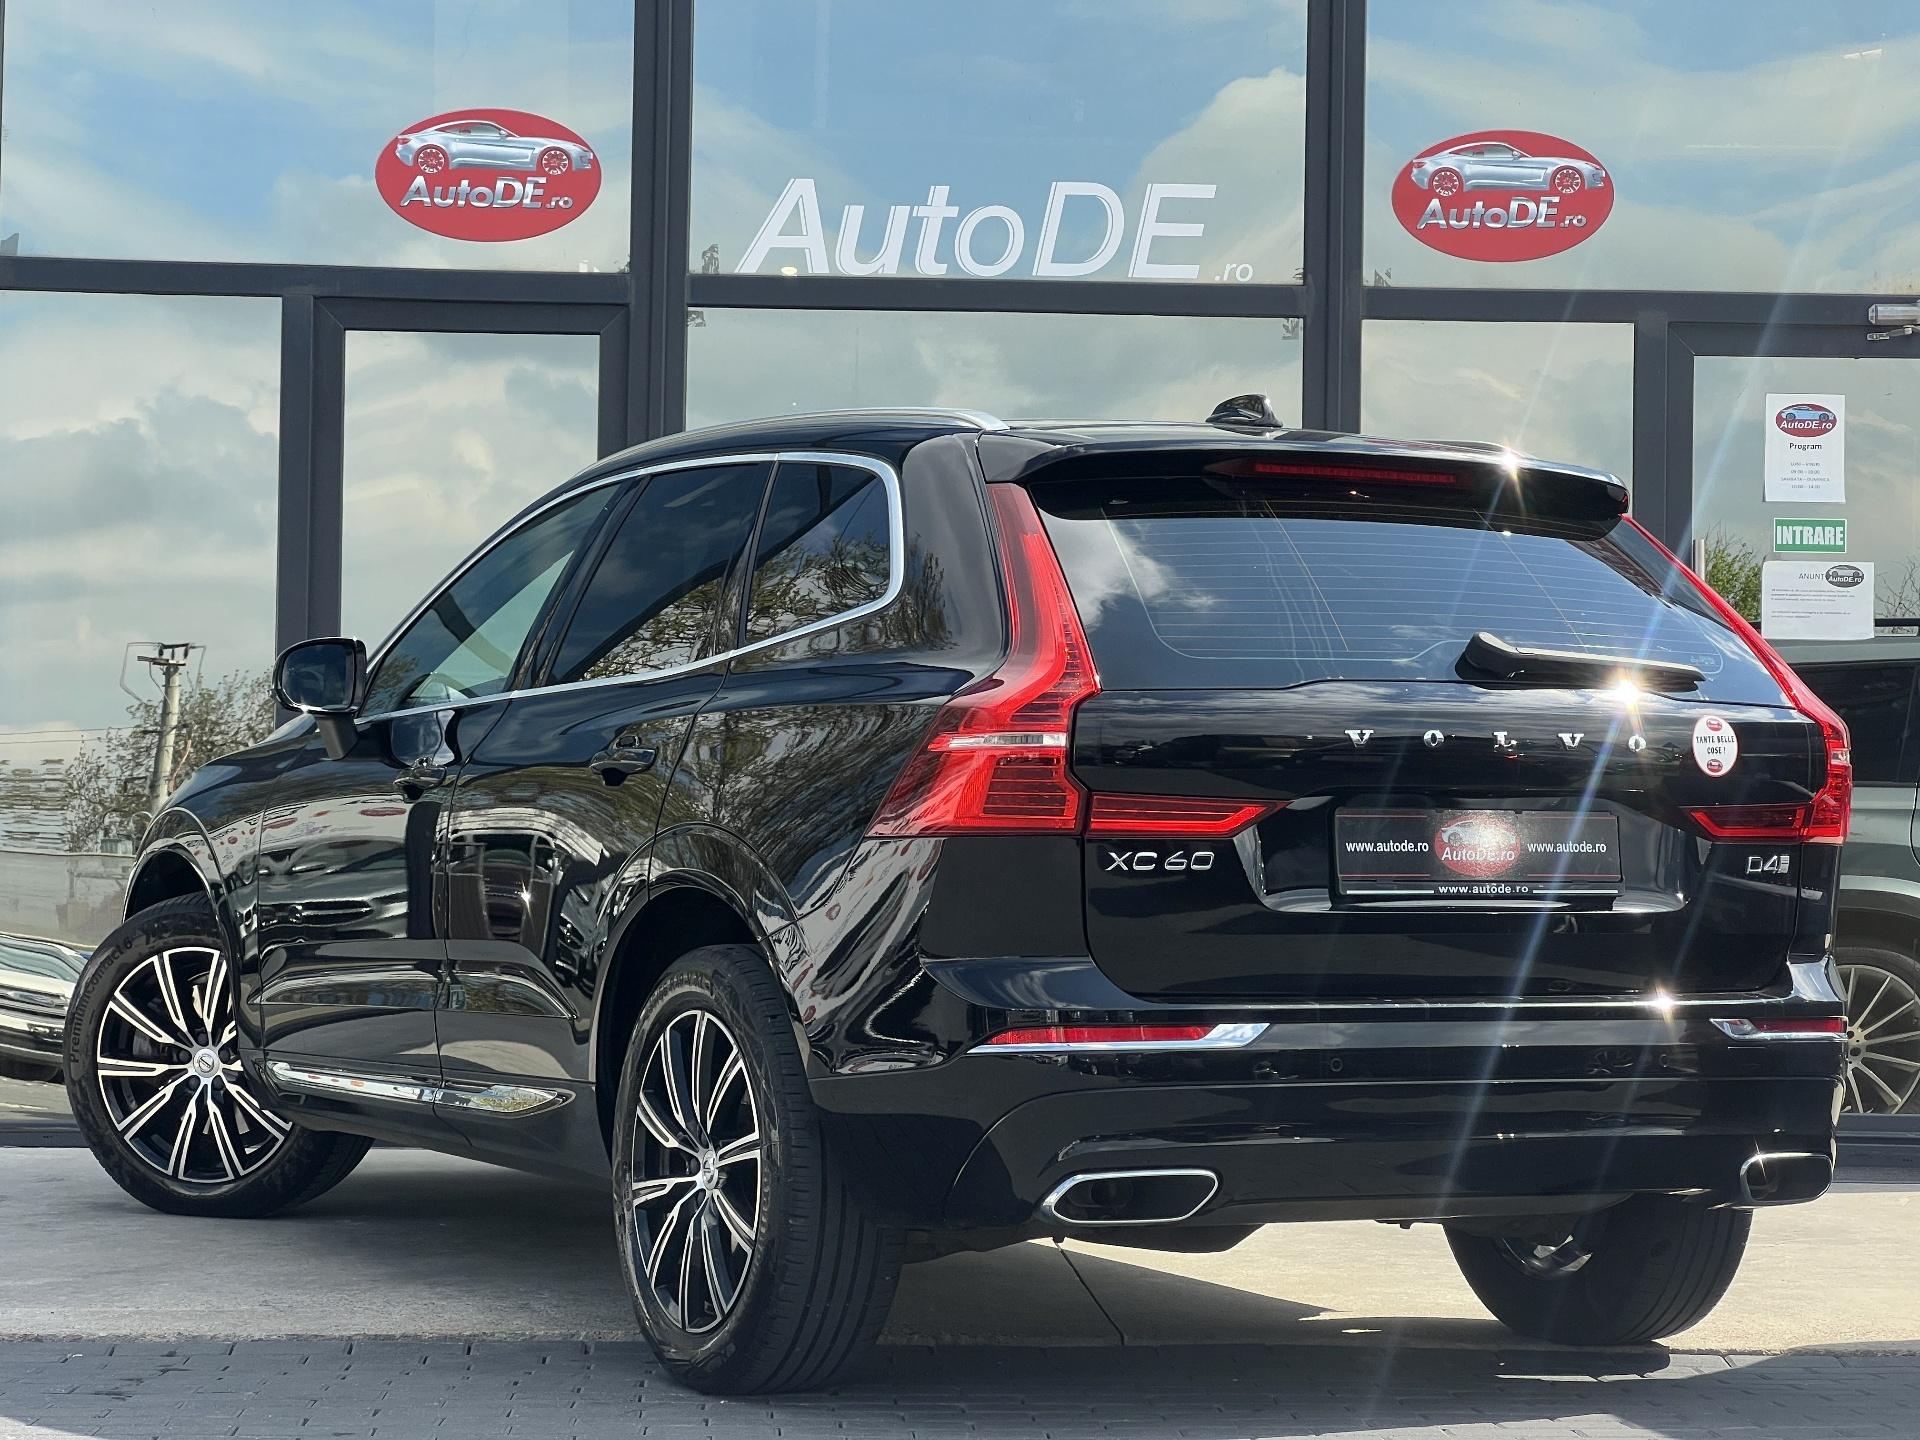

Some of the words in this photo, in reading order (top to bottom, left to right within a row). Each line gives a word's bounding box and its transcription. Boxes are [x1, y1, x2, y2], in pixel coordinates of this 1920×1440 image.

[1779, 420, 1833, 430] AutoDE.ro
[1789, 442, 1822, 451] Program
[1776, 525, 1844, 546] INTRARE
[1344, 729, 1647, 753] VOLVO
[1696, 735, 1715, 744] TANTE
[1717, 735, 1735, 744] BELLE
[1345, 839, 1429, 852] www.autode.ro
[1527, 841, 1607, 853] www.autode.ro
[1438, 883, 1529, 894] www.autode.ro
